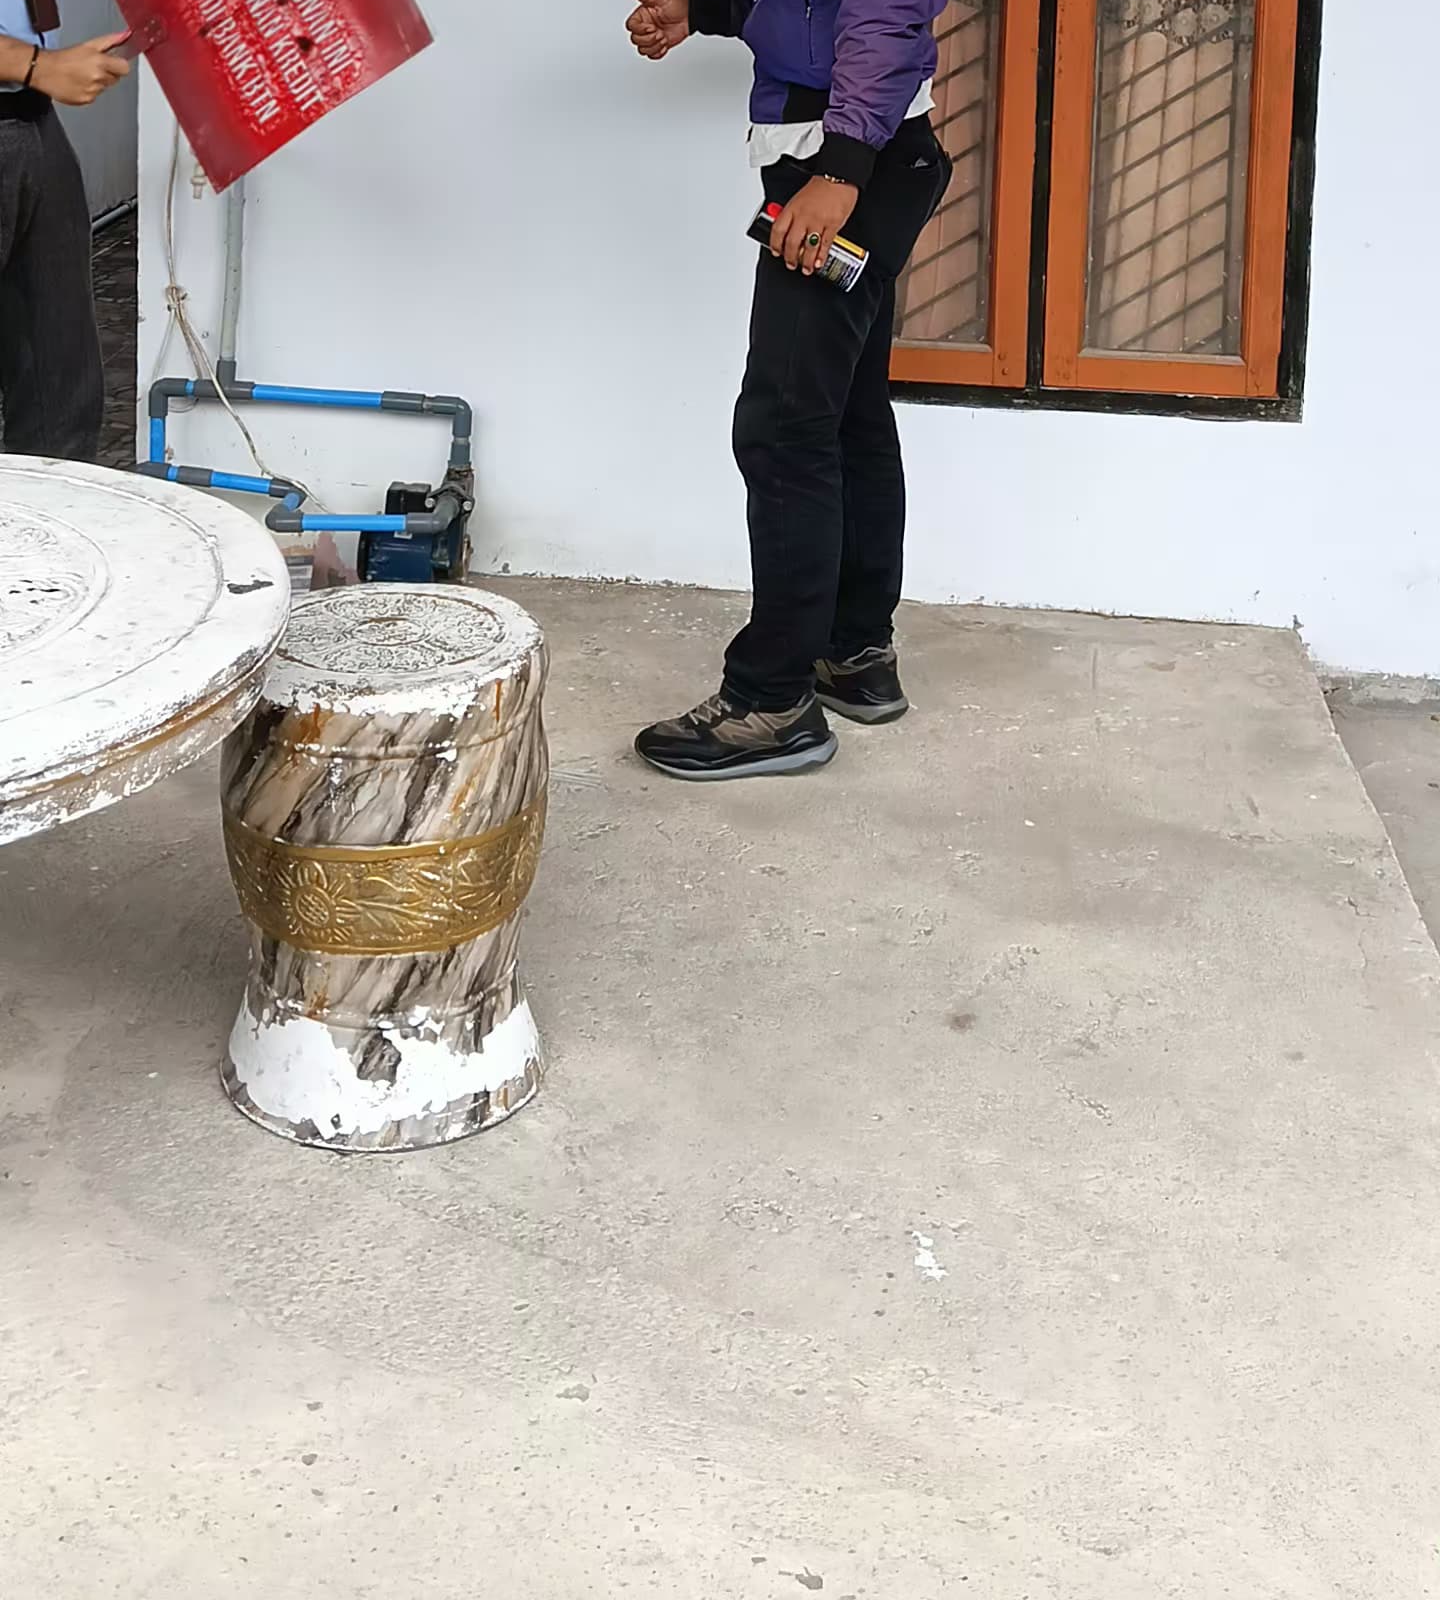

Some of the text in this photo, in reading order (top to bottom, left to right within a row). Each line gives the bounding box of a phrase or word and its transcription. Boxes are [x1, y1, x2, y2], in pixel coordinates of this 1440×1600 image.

[211, 16, 256, 80] BANK
[241, 73, 280, 123] BTN
[268, 33, 324, 112] KREDIT
[320, 38, 353, 74] INI
